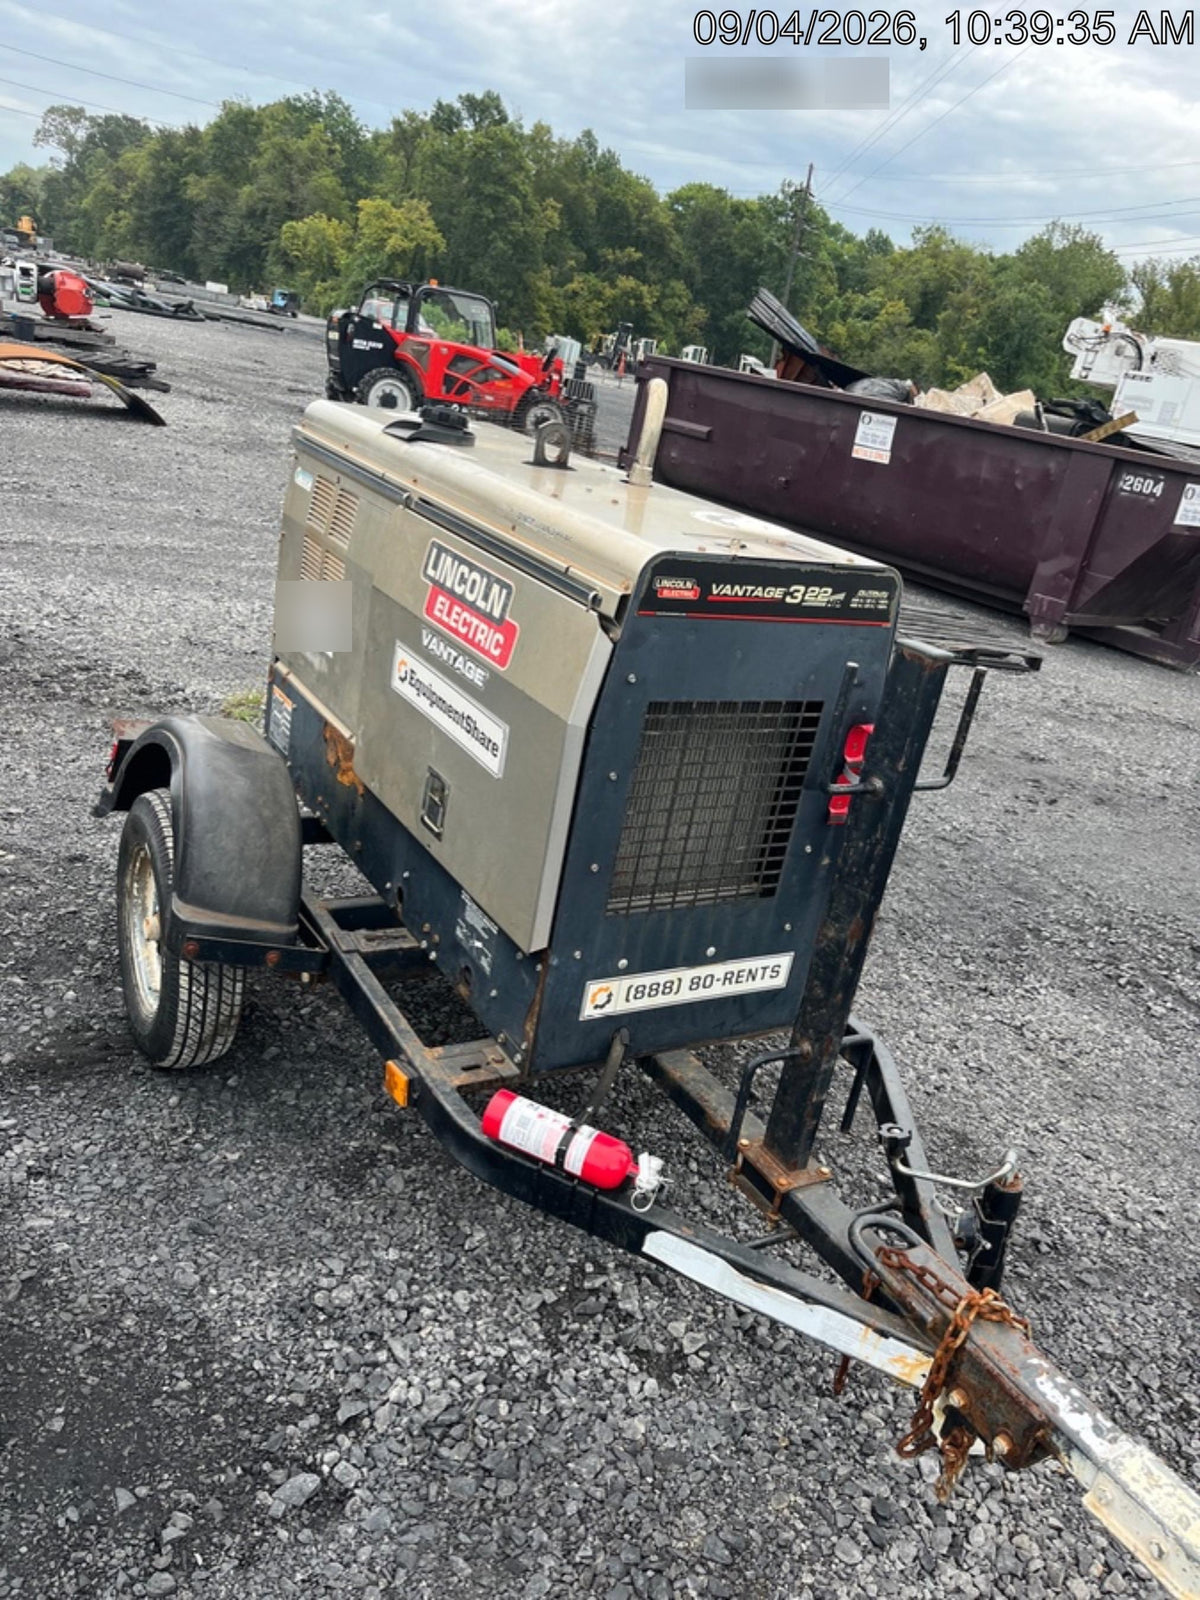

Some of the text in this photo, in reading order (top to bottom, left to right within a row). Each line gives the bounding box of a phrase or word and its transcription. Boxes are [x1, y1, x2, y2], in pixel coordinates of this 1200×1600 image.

[1122, 475, 1165, 497] 2604
[426, 547, 508, 619] LINCOLN
[655, 578, 694, 589] LINCOLN
[711, 583, 787, 599] VANTAGE
[785, 585, 833, 604] 322
[433, 595, 505, 657] ELECTRIC
[422, 629, 487, 688] VANTAGE
[407, 666, 500, 758] EquipmentShare
[625, 964, 782, 1003] (888) 80-RENTS
